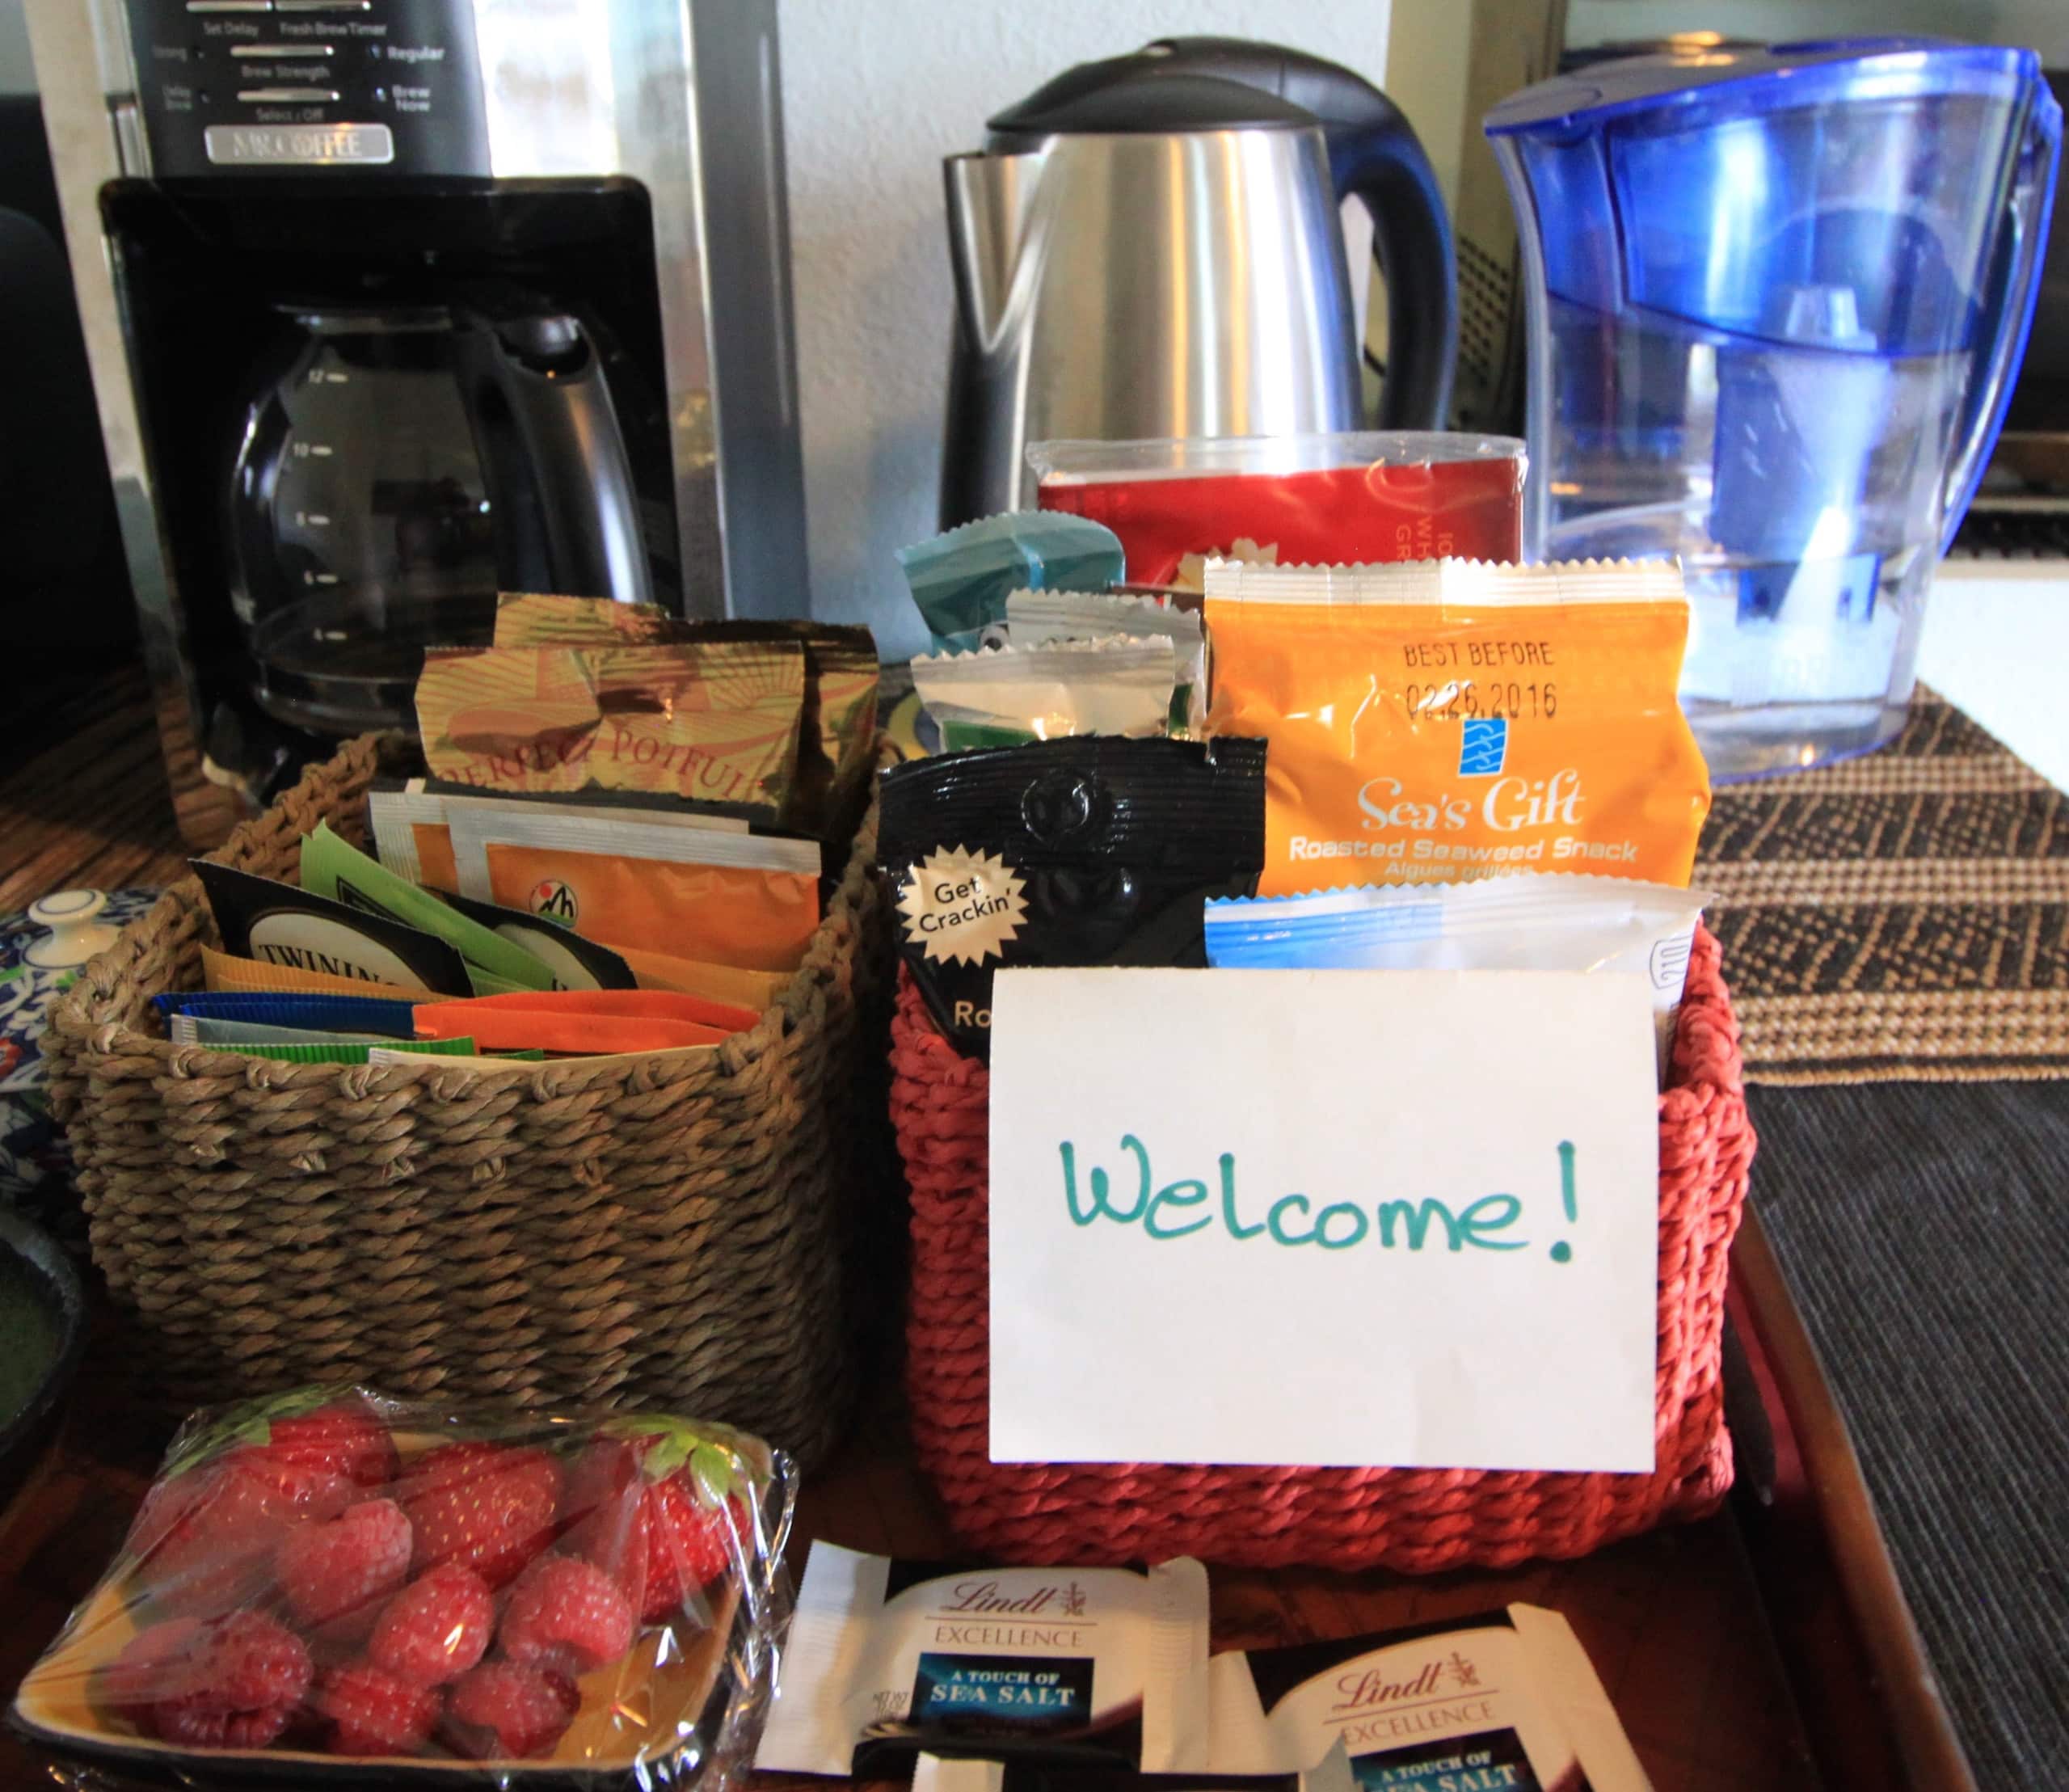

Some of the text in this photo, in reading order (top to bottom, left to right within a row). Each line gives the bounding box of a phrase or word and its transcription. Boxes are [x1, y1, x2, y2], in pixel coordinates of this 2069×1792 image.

[387, 45, 445, 64] Regular
[1404, 641, 1555, 667] BEST BEFORE
[1358, 769, 1587, 832] Sea's Gift
[1289, 836, 1639, 862] Roasted Seaweed Snack
[1385, 861, 1454, 882] Algues
[933, 877, 983, 904] Get
[919, 888, 1012, 933] Crackin'
[259, 943, 398, 986] TWININ
[938, 1581, 1058, 1614] Lindt
[935, 1625, 1084, 1649] EXCELLENCE
[952, 1670, 1060, 1685] A TOUCH OF
[1331, 1660, 1443, 1710] Lindt
[931, 1684, 1076, 1707] SEA SALT
[1342, 1701, 1495, 1747] EXCELLENCE
[1381, 1750, 1492, 1783] A TOUCH OF
[1438, 1763, 1517, 1792] SALT
